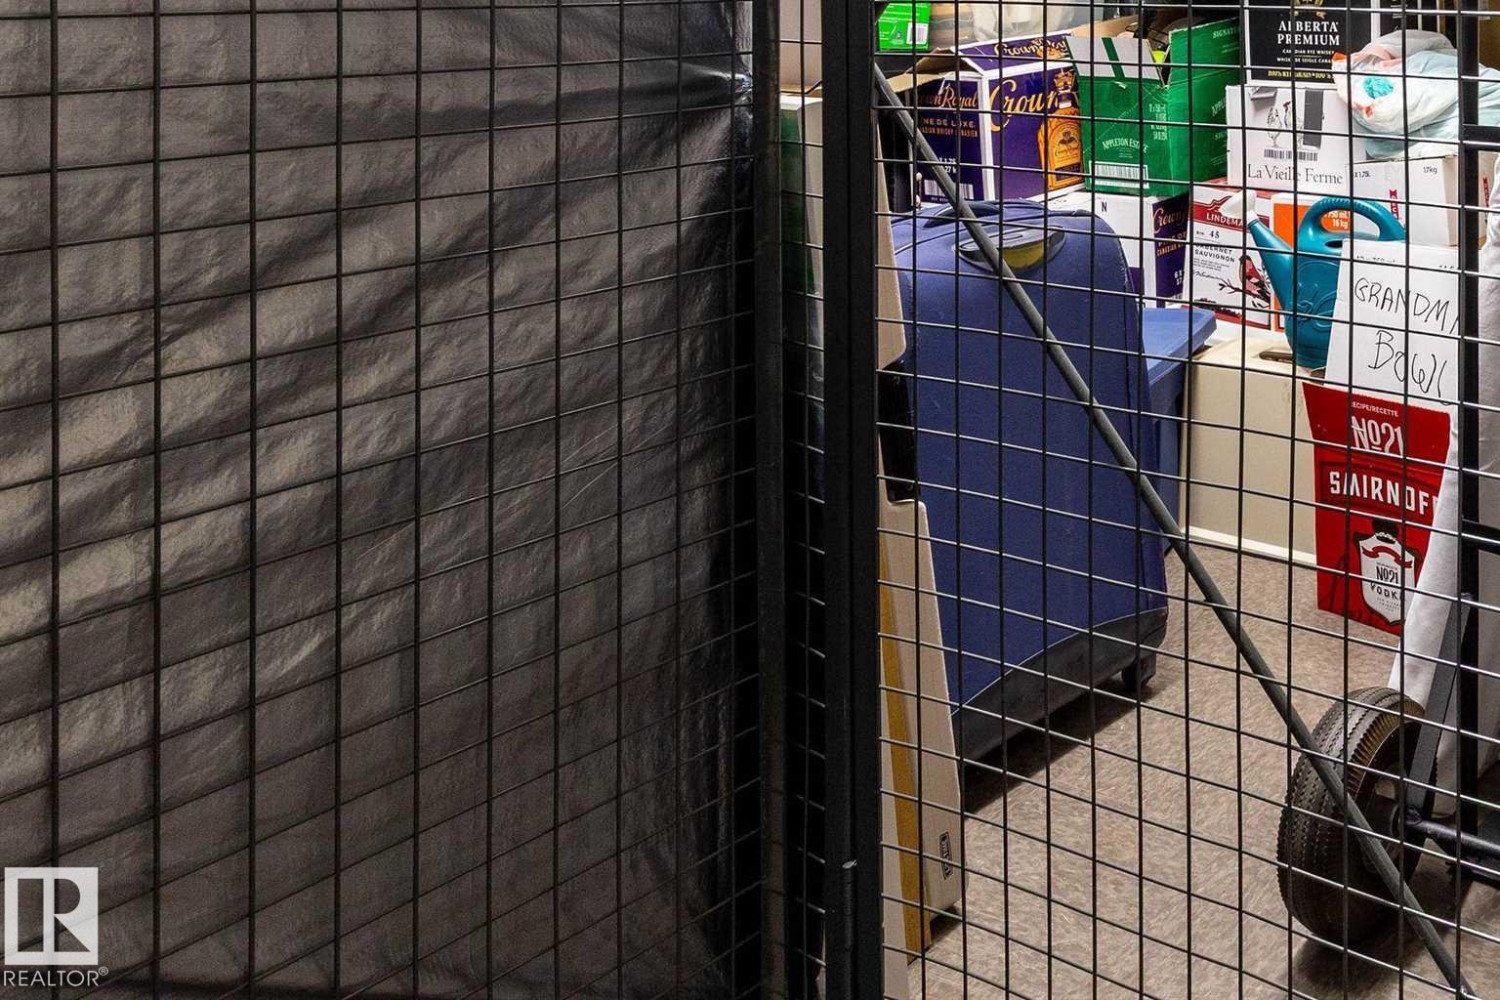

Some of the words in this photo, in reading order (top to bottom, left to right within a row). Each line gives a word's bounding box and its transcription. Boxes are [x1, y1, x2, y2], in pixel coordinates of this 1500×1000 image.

[1277, 33, 1340, 46] PREMIUM
[951, 120, 976, 128] LXE
[1248, 163, 1263, 179] La
[1264, 164, 1302, 181] Vieile
[1305, 168, 1344, 184] Ferme
[1206, 212, 1243, 227] LINDEMA
[1209, 230, 1220, 239] 45
[1194, 249, 1235, 264] SAUVIGNON
[1370, 582, 1398, 600] VODK
